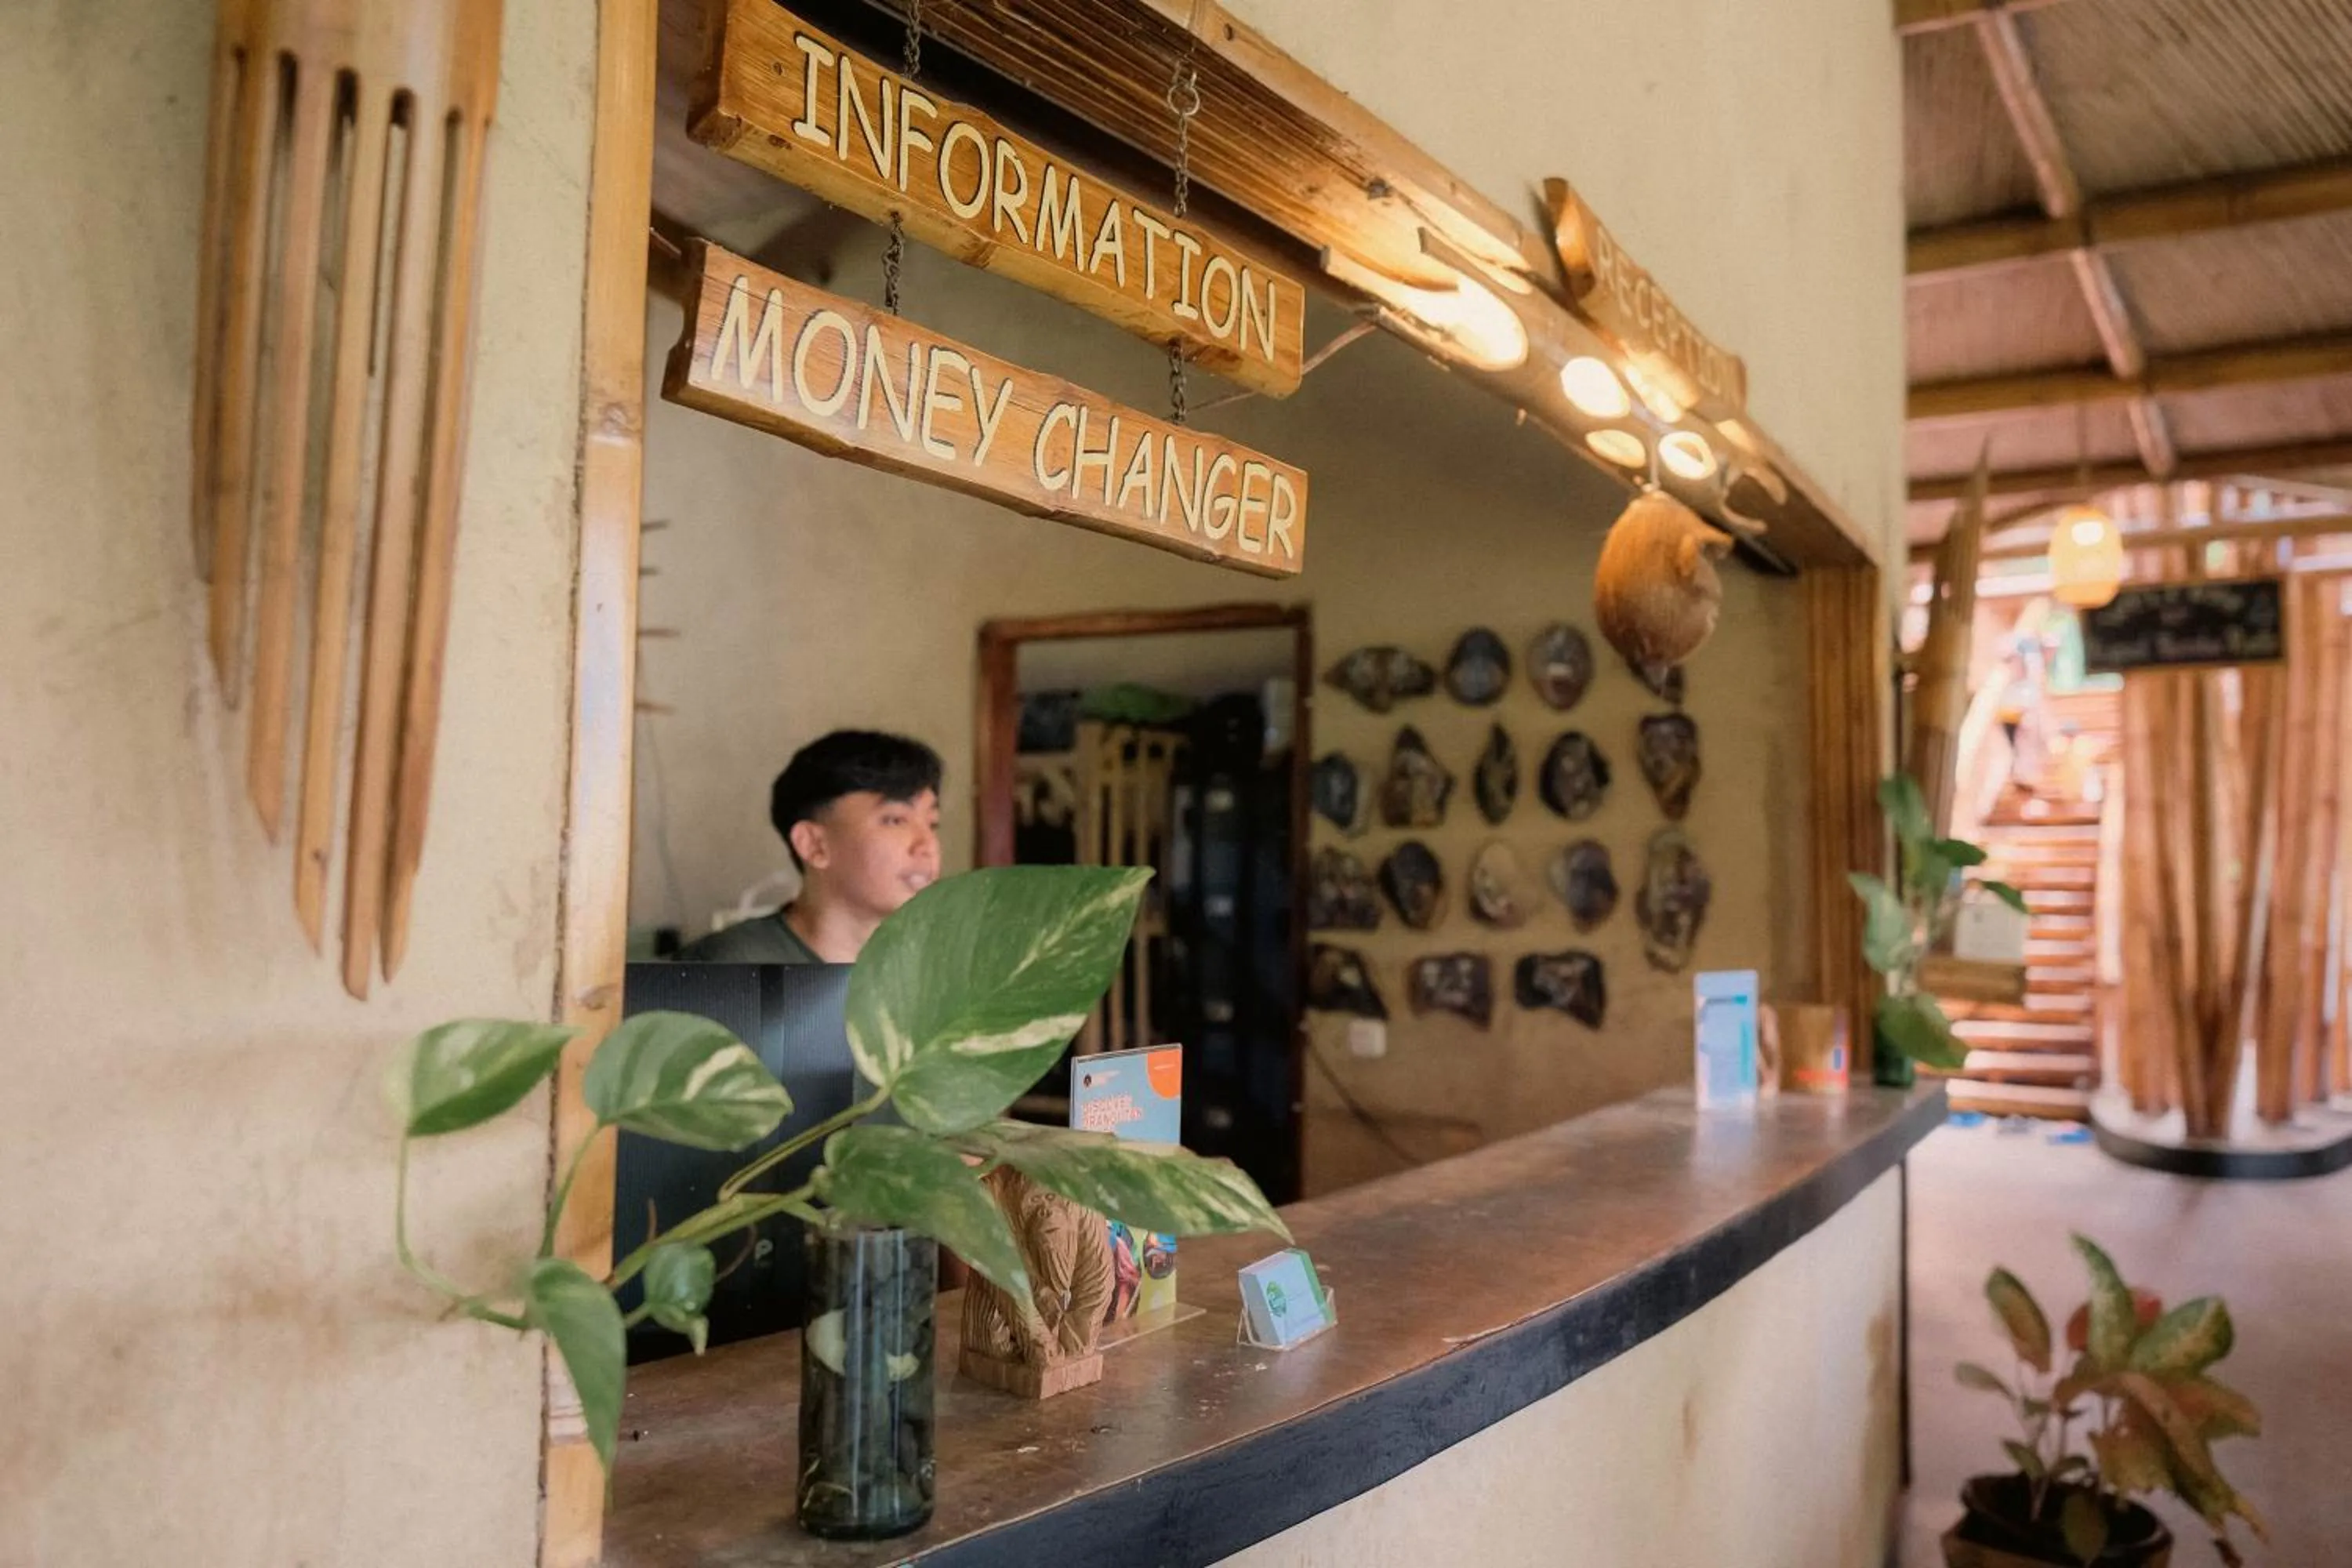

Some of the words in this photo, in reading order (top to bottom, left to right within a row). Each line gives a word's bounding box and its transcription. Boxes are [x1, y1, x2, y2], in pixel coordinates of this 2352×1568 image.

[791, 31, 1276, 363] INFORMATION
[710, 273, 1012, 468] MONEY
[1033, 401, 1298, 559] CHANGER
